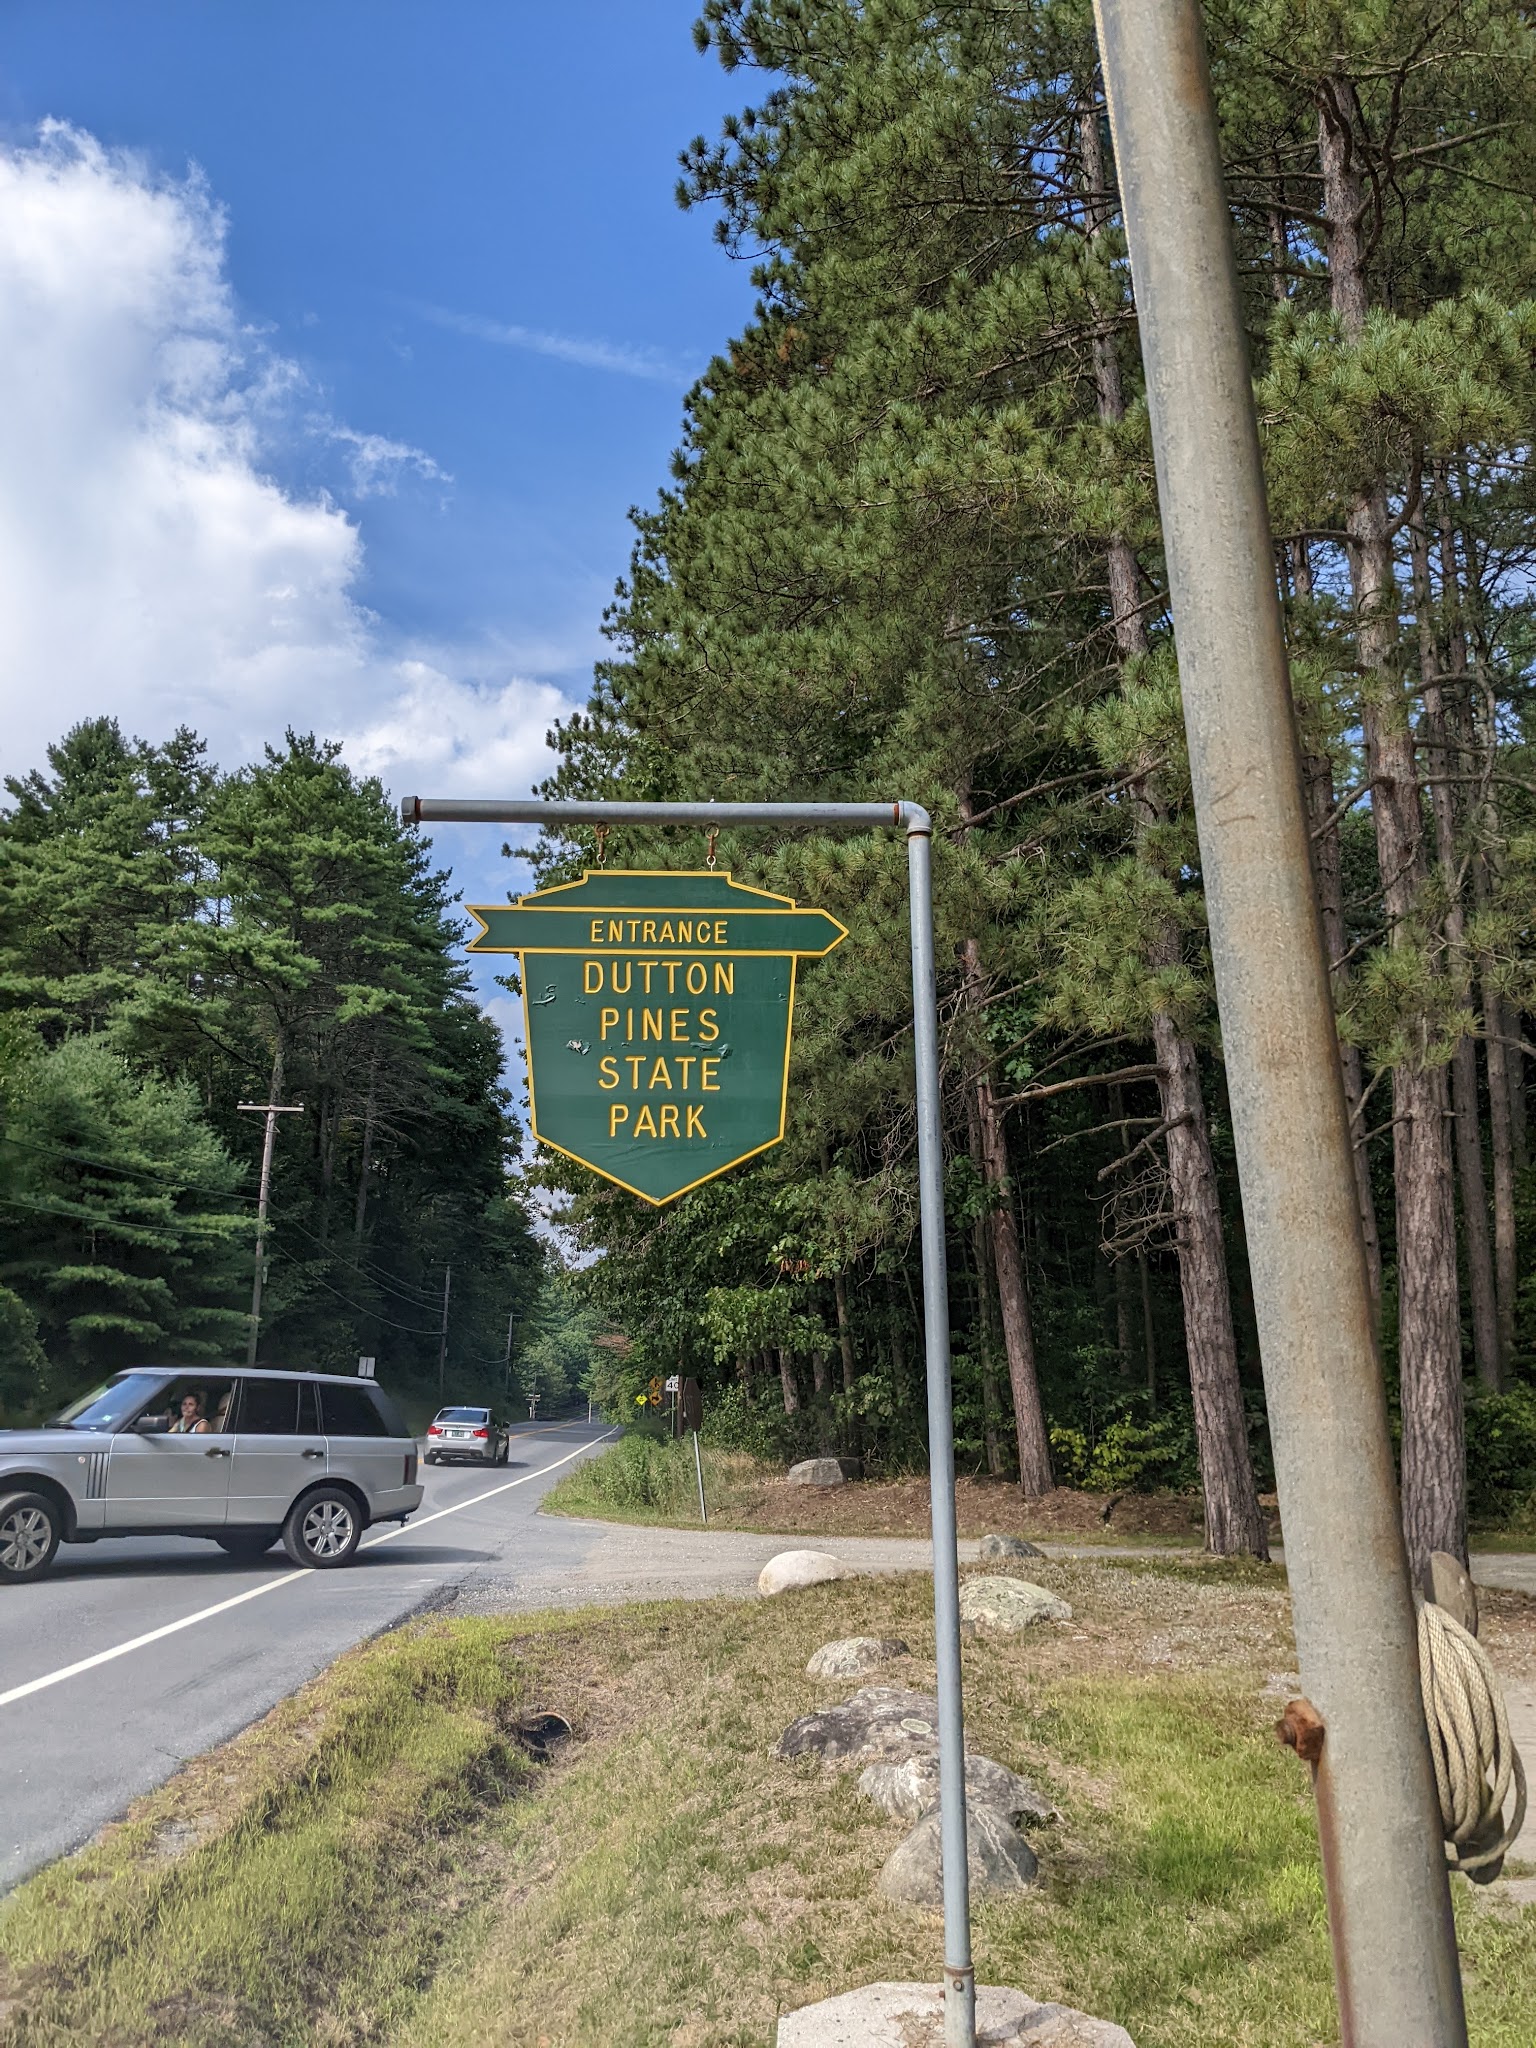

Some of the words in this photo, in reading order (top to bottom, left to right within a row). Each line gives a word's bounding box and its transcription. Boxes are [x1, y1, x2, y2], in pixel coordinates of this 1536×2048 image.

[590, 919, 729, 944] ENTRANCE
[583, 960, 735, 995] DUTTON
[600, 1007, 720, 1042] PINES
[597, 1055, 722, 1091] STATE
[609, 1103, 708, 1139] PARK
